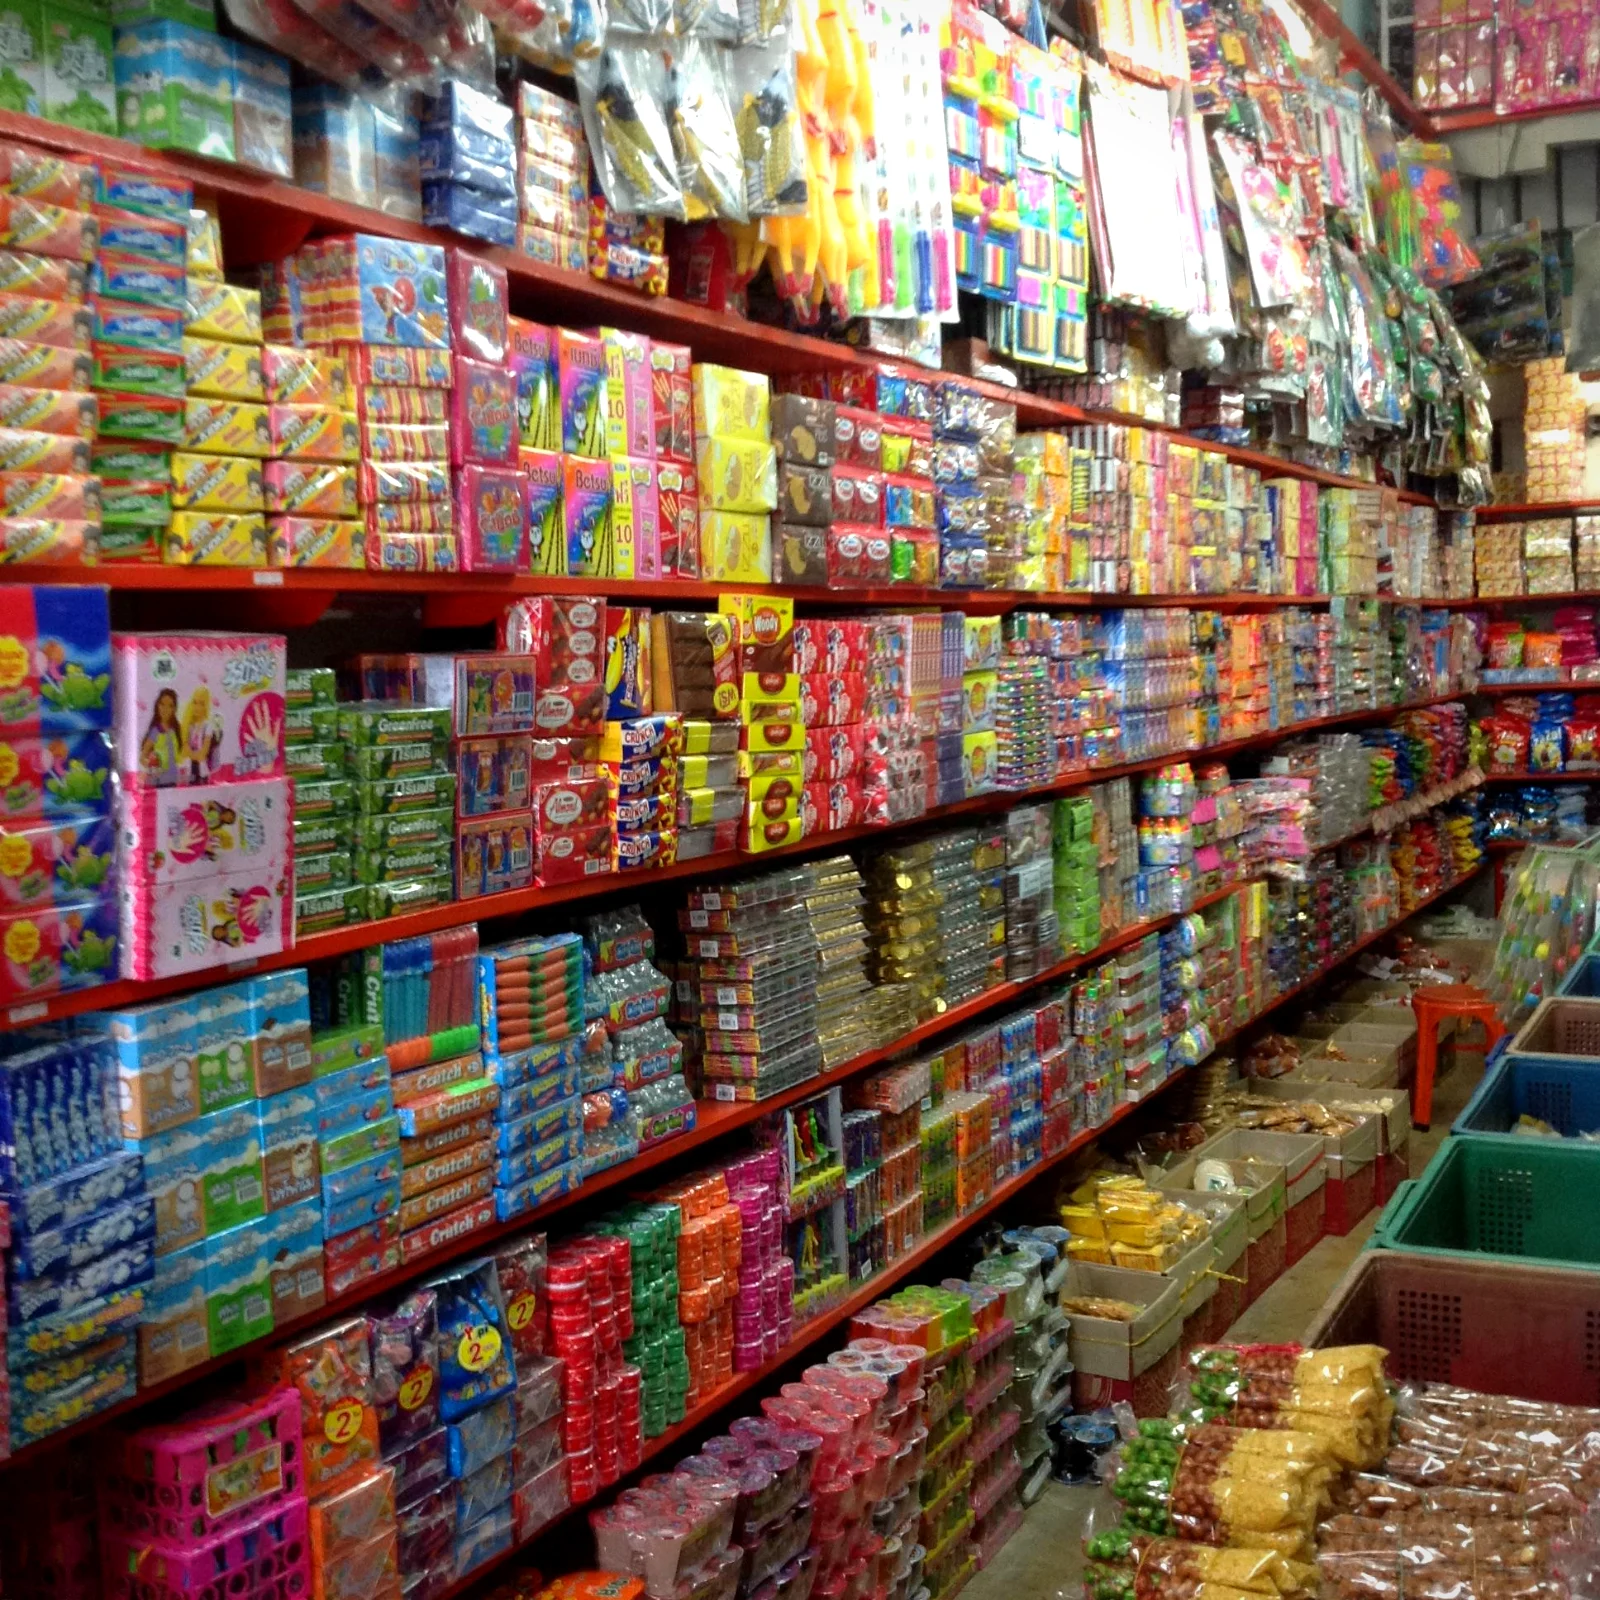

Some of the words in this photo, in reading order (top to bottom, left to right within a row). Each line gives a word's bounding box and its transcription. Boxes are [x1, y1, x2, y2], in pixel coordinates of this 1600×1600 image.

[608, 400, 624, 419] 10
[575, 468, 608, 493] Betsu
[616, 525, 632, 544] 10
[378, 716, 434, 732] Greenfree
[620, 802, 649, 820] CRUNCH
[387, 819, 438, 835] Greenfree
[620, 839, 650, 857] CRUNCH
[425, 1154, 473, 1182] Crutch
[430, 1216, 474, 1246] Crutch
[516, 1302, 527, 1325] 2
[469, 1342, 483, 1364] 2
[409, 1379, 424, 1405] 2
[336, 1411, 351, 1438] 2
